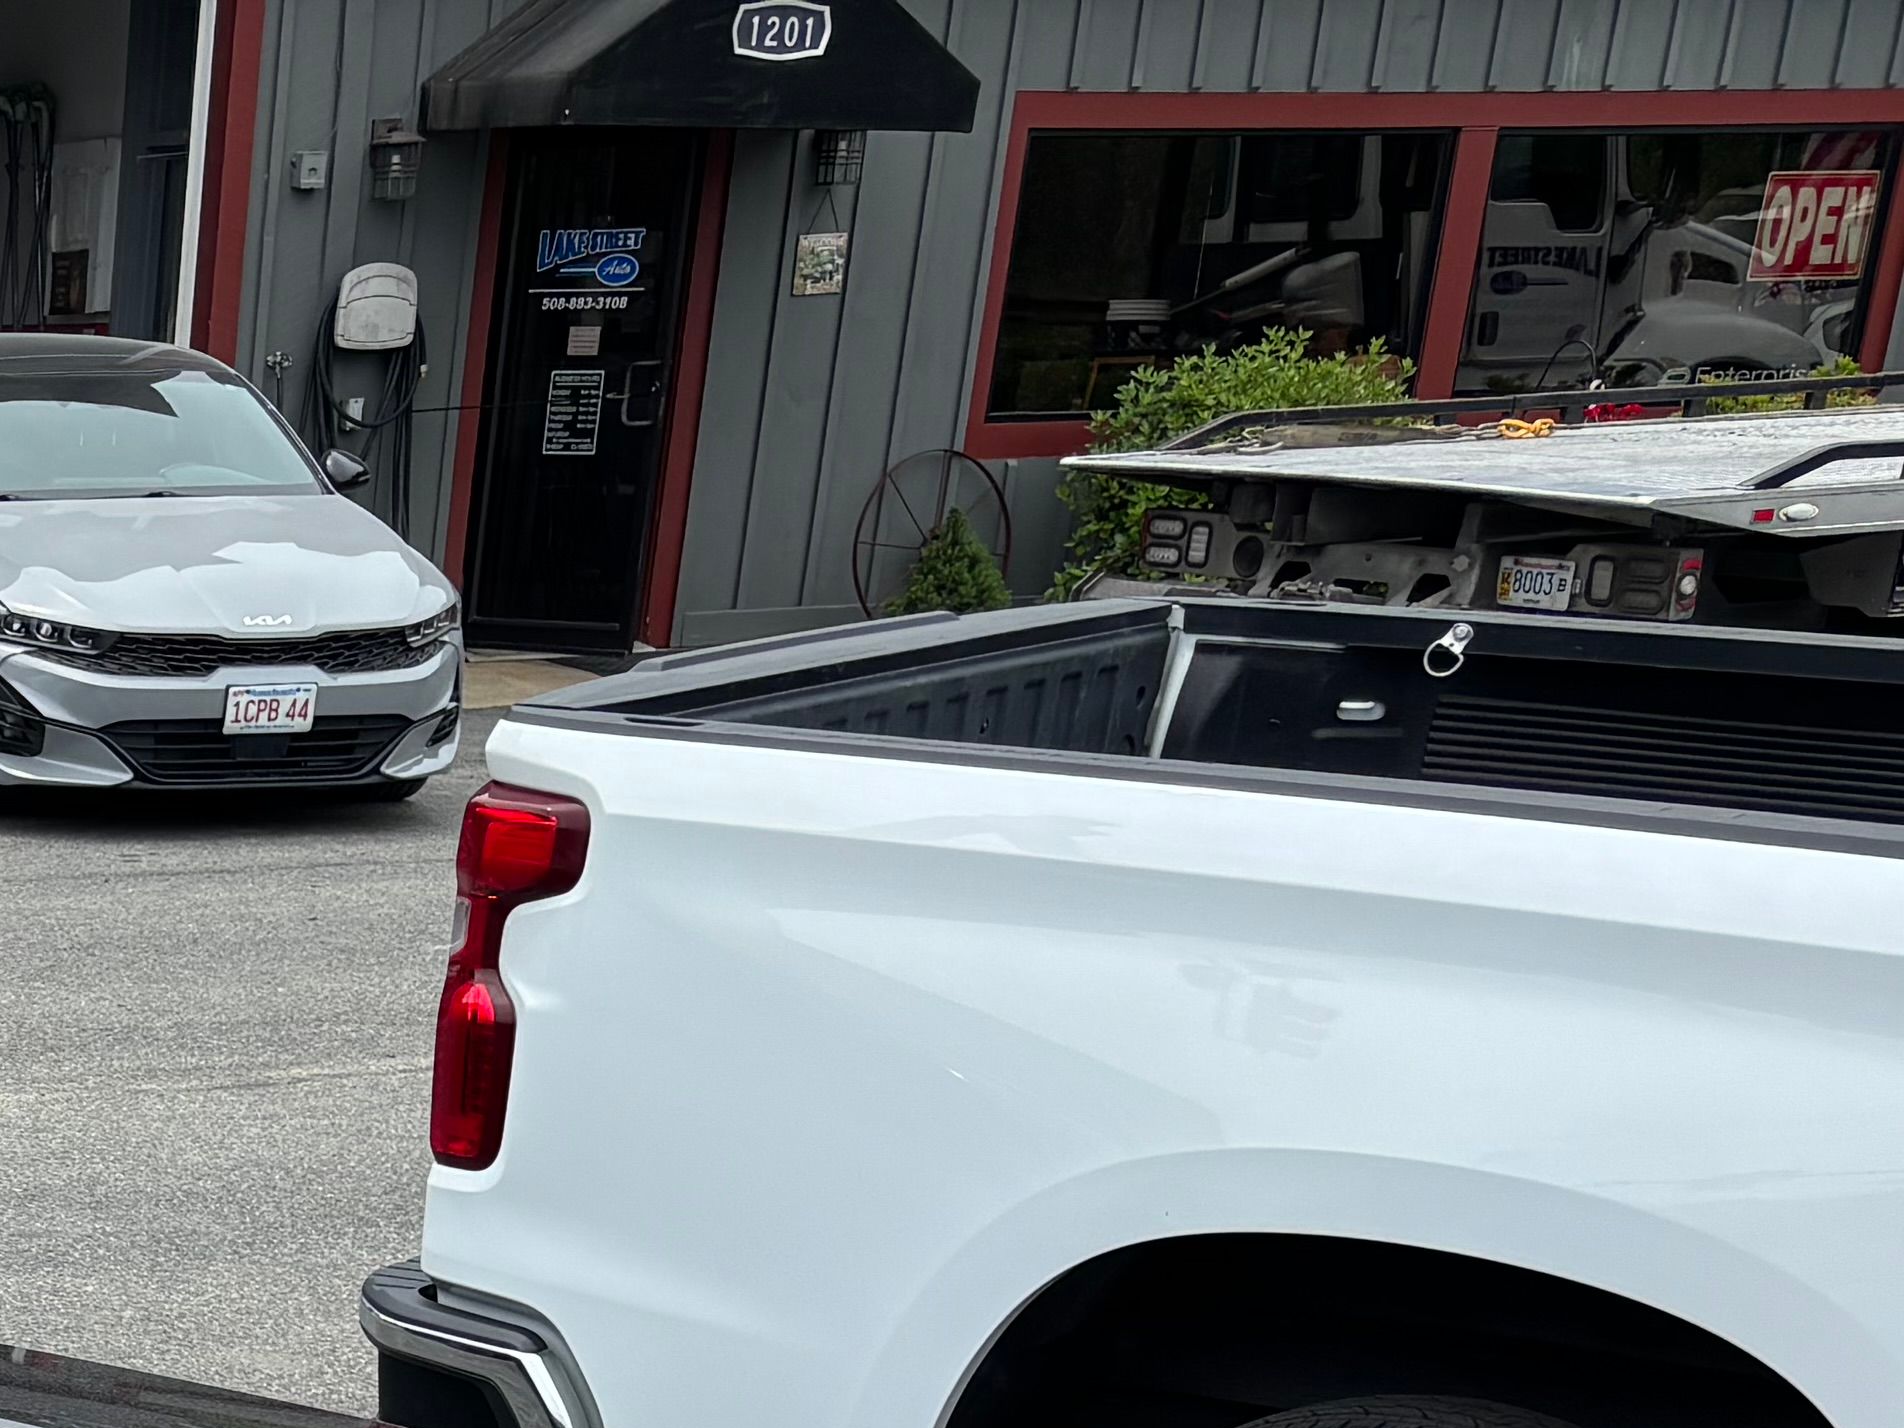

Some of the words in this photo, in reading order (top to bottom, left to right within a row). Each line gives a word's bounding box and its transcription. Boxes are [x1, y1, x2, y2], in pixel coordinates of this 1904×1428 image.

[750, 15, 814, 48] 1201
[1761, 185, 1872, 268] OPEN
[537, 229, 589, 272] LAKE
[587, 228, 647, 255] STREET
[1695, 364, 1810, 384] Enterpris
[1513, 569, 1556, 596] 8003
[230, 699, 281, 724] 1CPB
[285, 698, 310, 722] 44
